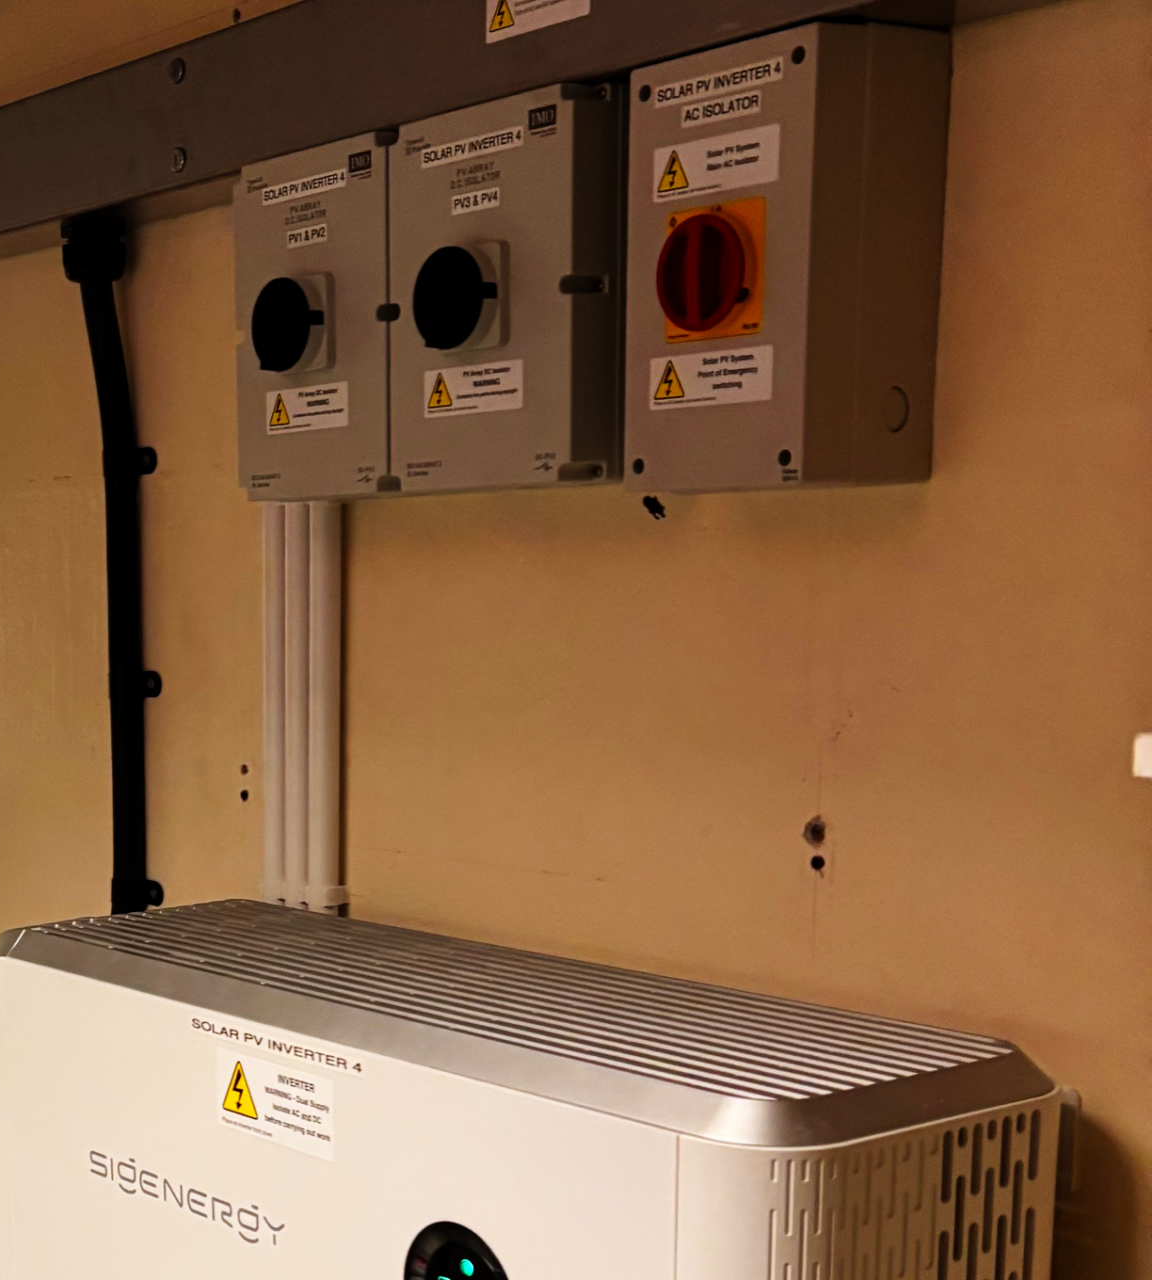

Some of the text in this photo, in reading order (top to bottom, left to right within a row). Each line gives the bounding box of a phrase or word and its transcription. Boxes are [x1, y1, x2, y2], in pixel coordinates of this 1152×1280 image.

[657, 61, 781, 102] SOLAR PV INVERTER 4
[531, 109, 554, 126] IMO
[684, 94, 759, 122] AC ISOLATOR
[423, 147, 452, 163] SOLAR
[454, 144, 466, 156] PV
[468, 132, 513, 152] INVERTER
[515, 130, 522, 140] 4
[707, 142, 760, 159] Solar PV System
[351, 154, 370, 170] IMO
[468, 161, 495, 174] ARRAY
[724, 159, 734, 168] AC
[263, 186, 288, 201] SOLAR
[289, 184, 300, 195] PV
[300, 173, 338, 192] INVERTER
[339, 172, 345, 181] 4
[454, 190, 498, 210] PV3 & PV4
[288, 227, 326, 244] PV1 & PV2
[702, 354, 754, 366] Solar PV System
[698, 366, 758, 378] Point of Emergency
[191, 1018, 363, 1073] SOLAR PV INVERTER 4
[277, 1074, 316, 1093] INVERTER
[264, 1086, 292, 1101] WARNING
[296, 1095, 309, 1106] Dual
[310, 1100, 330, 1114] Supply
[301, 1112, 312, 1122] and
[264, 1114, 282, 1127] before
[283, 1121, 305, 1136] carrying
[306, 1127, 316, 1137] out
[316, 1131, 331, 1142] work
[89, 1149, 286, 1246] SIGENERGY
